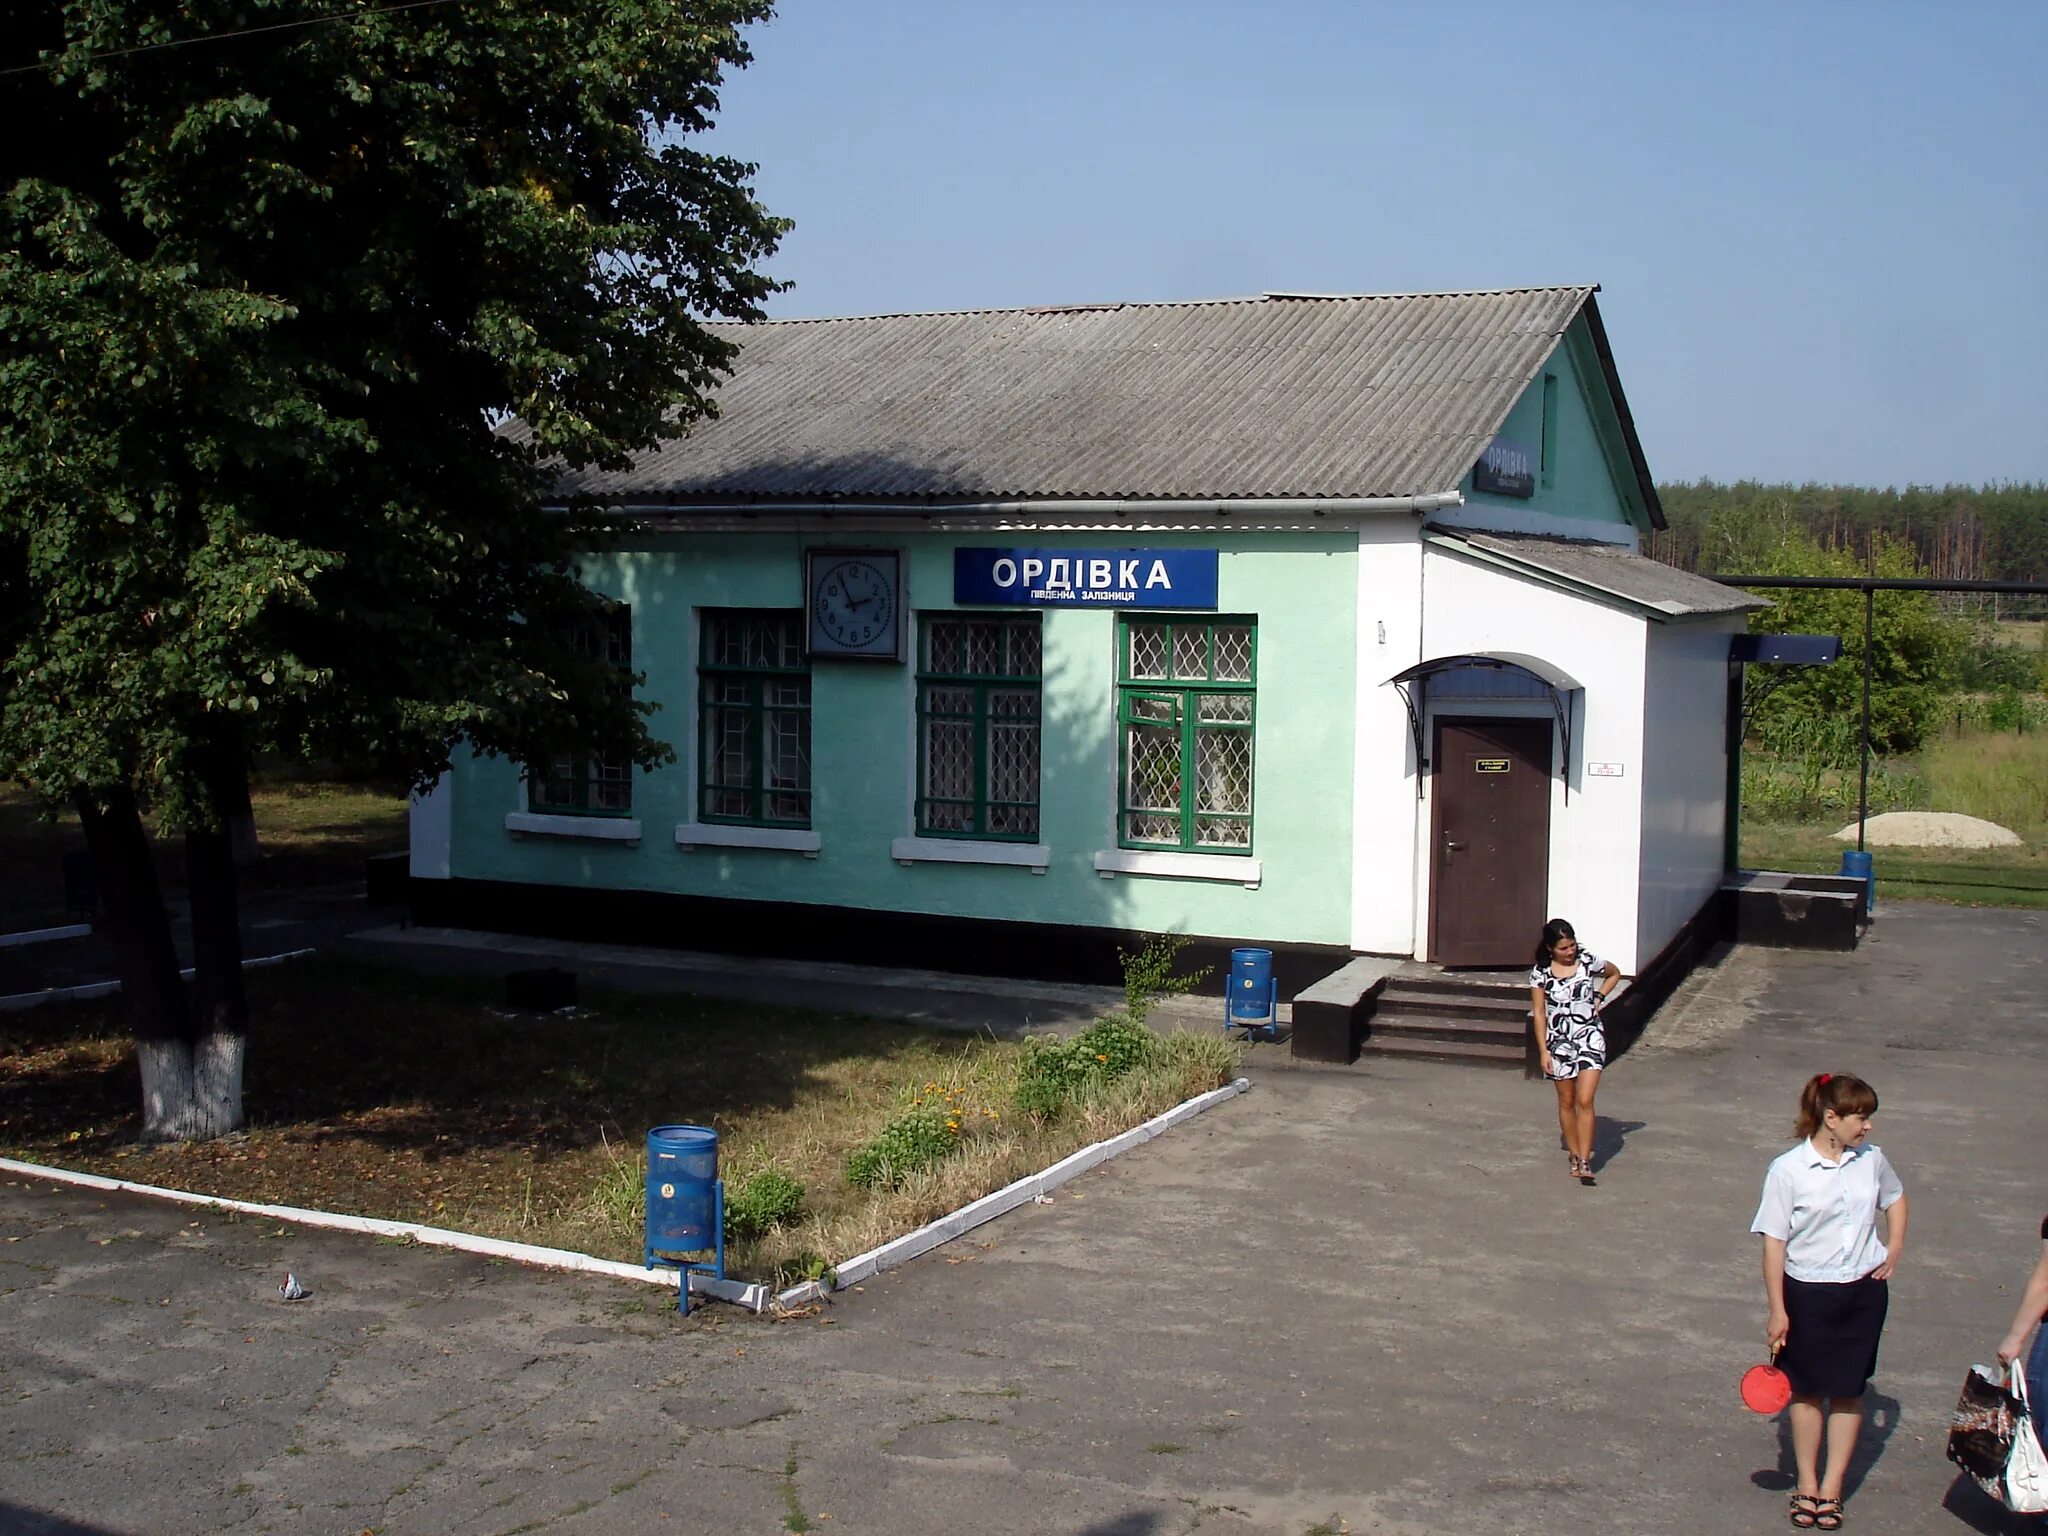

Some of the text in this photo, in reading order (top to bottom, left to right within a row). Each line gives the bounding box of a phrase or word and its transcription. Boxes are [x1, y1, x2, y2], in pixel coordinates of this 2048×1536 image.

[1488, 446, 1528, 480] ОРДІВКА
[849, 566, 859, 578] 12
[992, 558, 1172, 591] ОРДІВКА
[828, 585, 838, 597] 10
[872, 584, 880, 596] 2
[1031, 589, 1135, 602] ПІВДЕННА ЗАЛІЗНИЦЯ
[822, 598, 828, 610] 9
[879, 597, 886, 610] 3
[873, 612, 880, 624] 4
[837, 626, 844, 639] 7
[864, 626, 870, 638] 5
